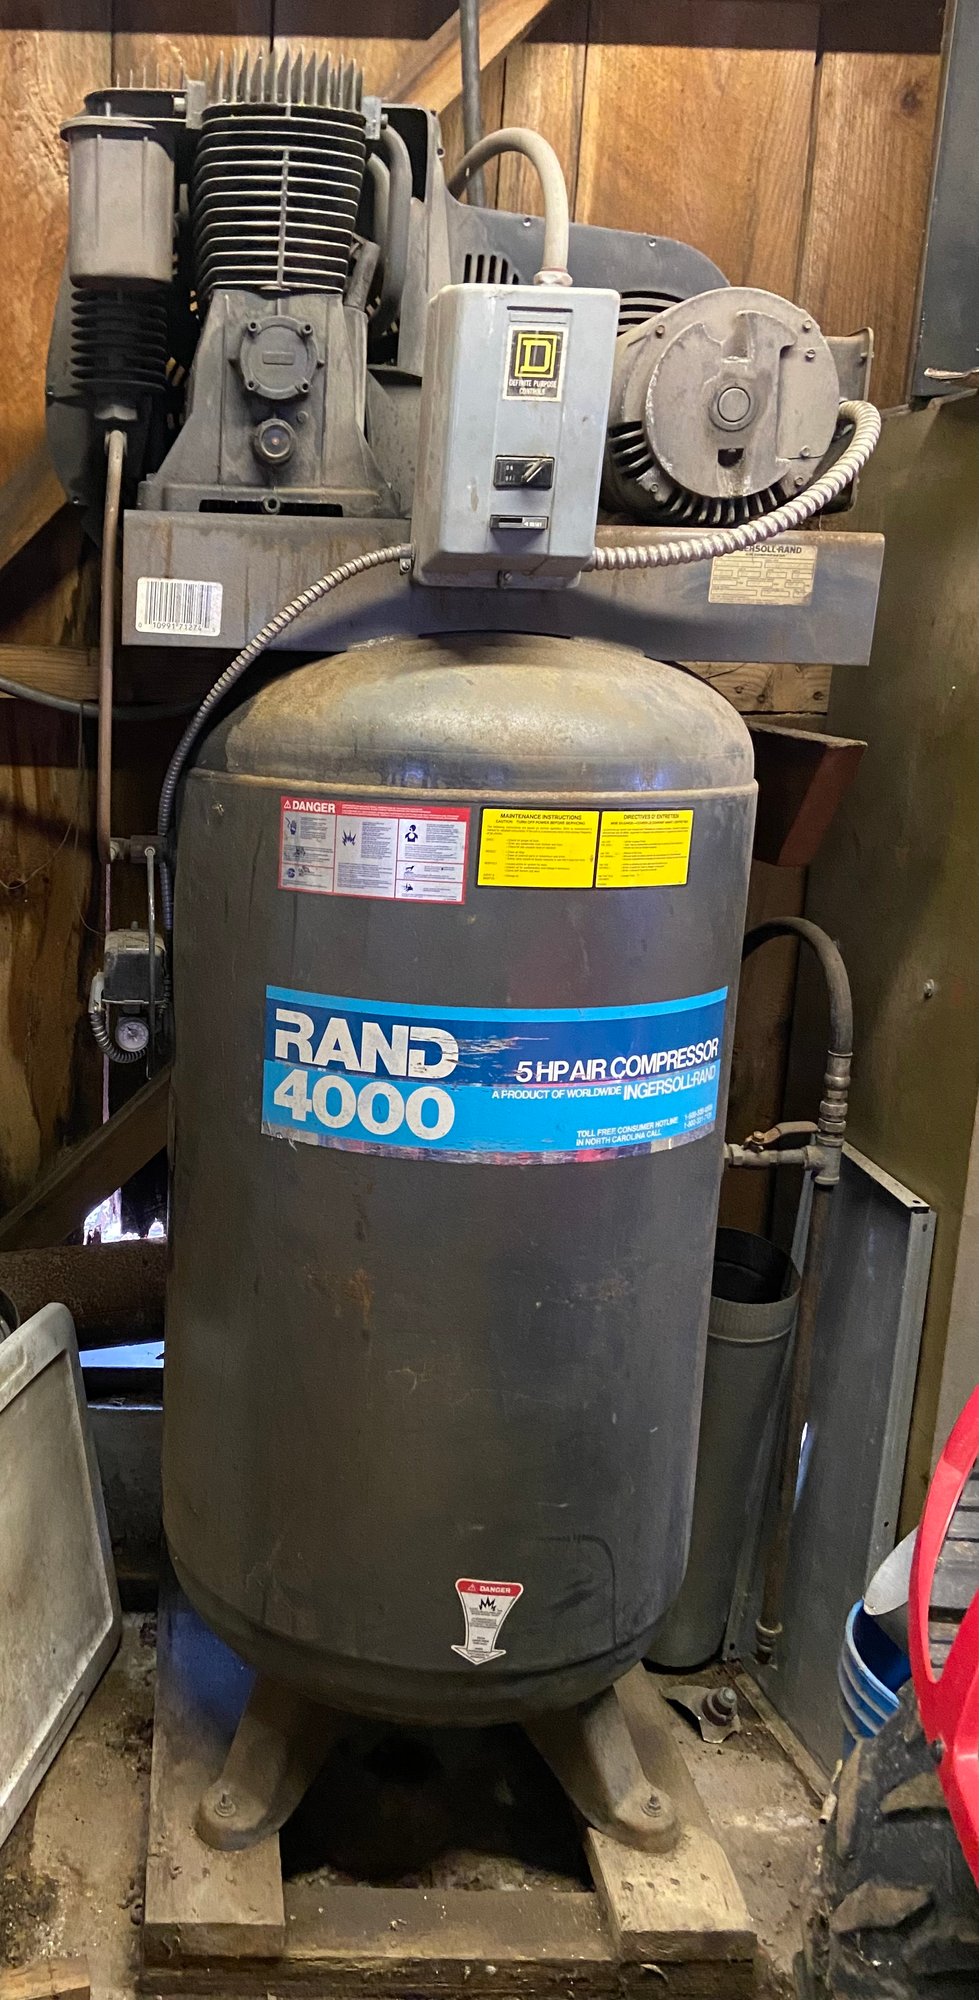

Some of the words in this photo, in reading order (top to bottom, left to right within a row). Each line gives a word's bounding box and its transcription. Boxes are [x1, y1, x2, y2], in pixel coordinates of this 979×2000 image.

[508, 379, 532, 387] DEFINITE
[533, 380, 557, 388] PURPOSE
[519, 387, 546, 396] CONTROLS
[153, 621, 175, 629] 10991
[292, 800, 336, 814] DANGER
[274, 1008, 459, 1079] RAND
[516, 1060, 533, 1083] 5
[536, 1060, 570, 1082] HP
[569, 1058, 607, 1081] AIR
[610, 1037, 719, 1079] COMPRESSOR
[491, 1091, 500, 1099] A
[501, 1089, 550, 1099] PRODUCT
[551, 1089, 565, 1099] OF
[566, 1085, 622, 1098] WORLDWIDE
[623, 1064, 716, 1101] INGERSOLL-RAND
[273, 1068, 455, 1140] 4000
[576, 1129, 596, 1138] TOLL
[596, 1127, 616, 1136] FREE
[617, 1121, 655, 1134] CONSUMER
[655, 1116, 679, 1128] HOTLINE
[576, 1138, 584, 1146] IN
[585, 1136, 611, 1146] NORTH
[611, 1132, 646, 1143] CAROLINA
[646, 1129, 662, 1138] CALL
[479, 1585, 511, 1593] DANGER
